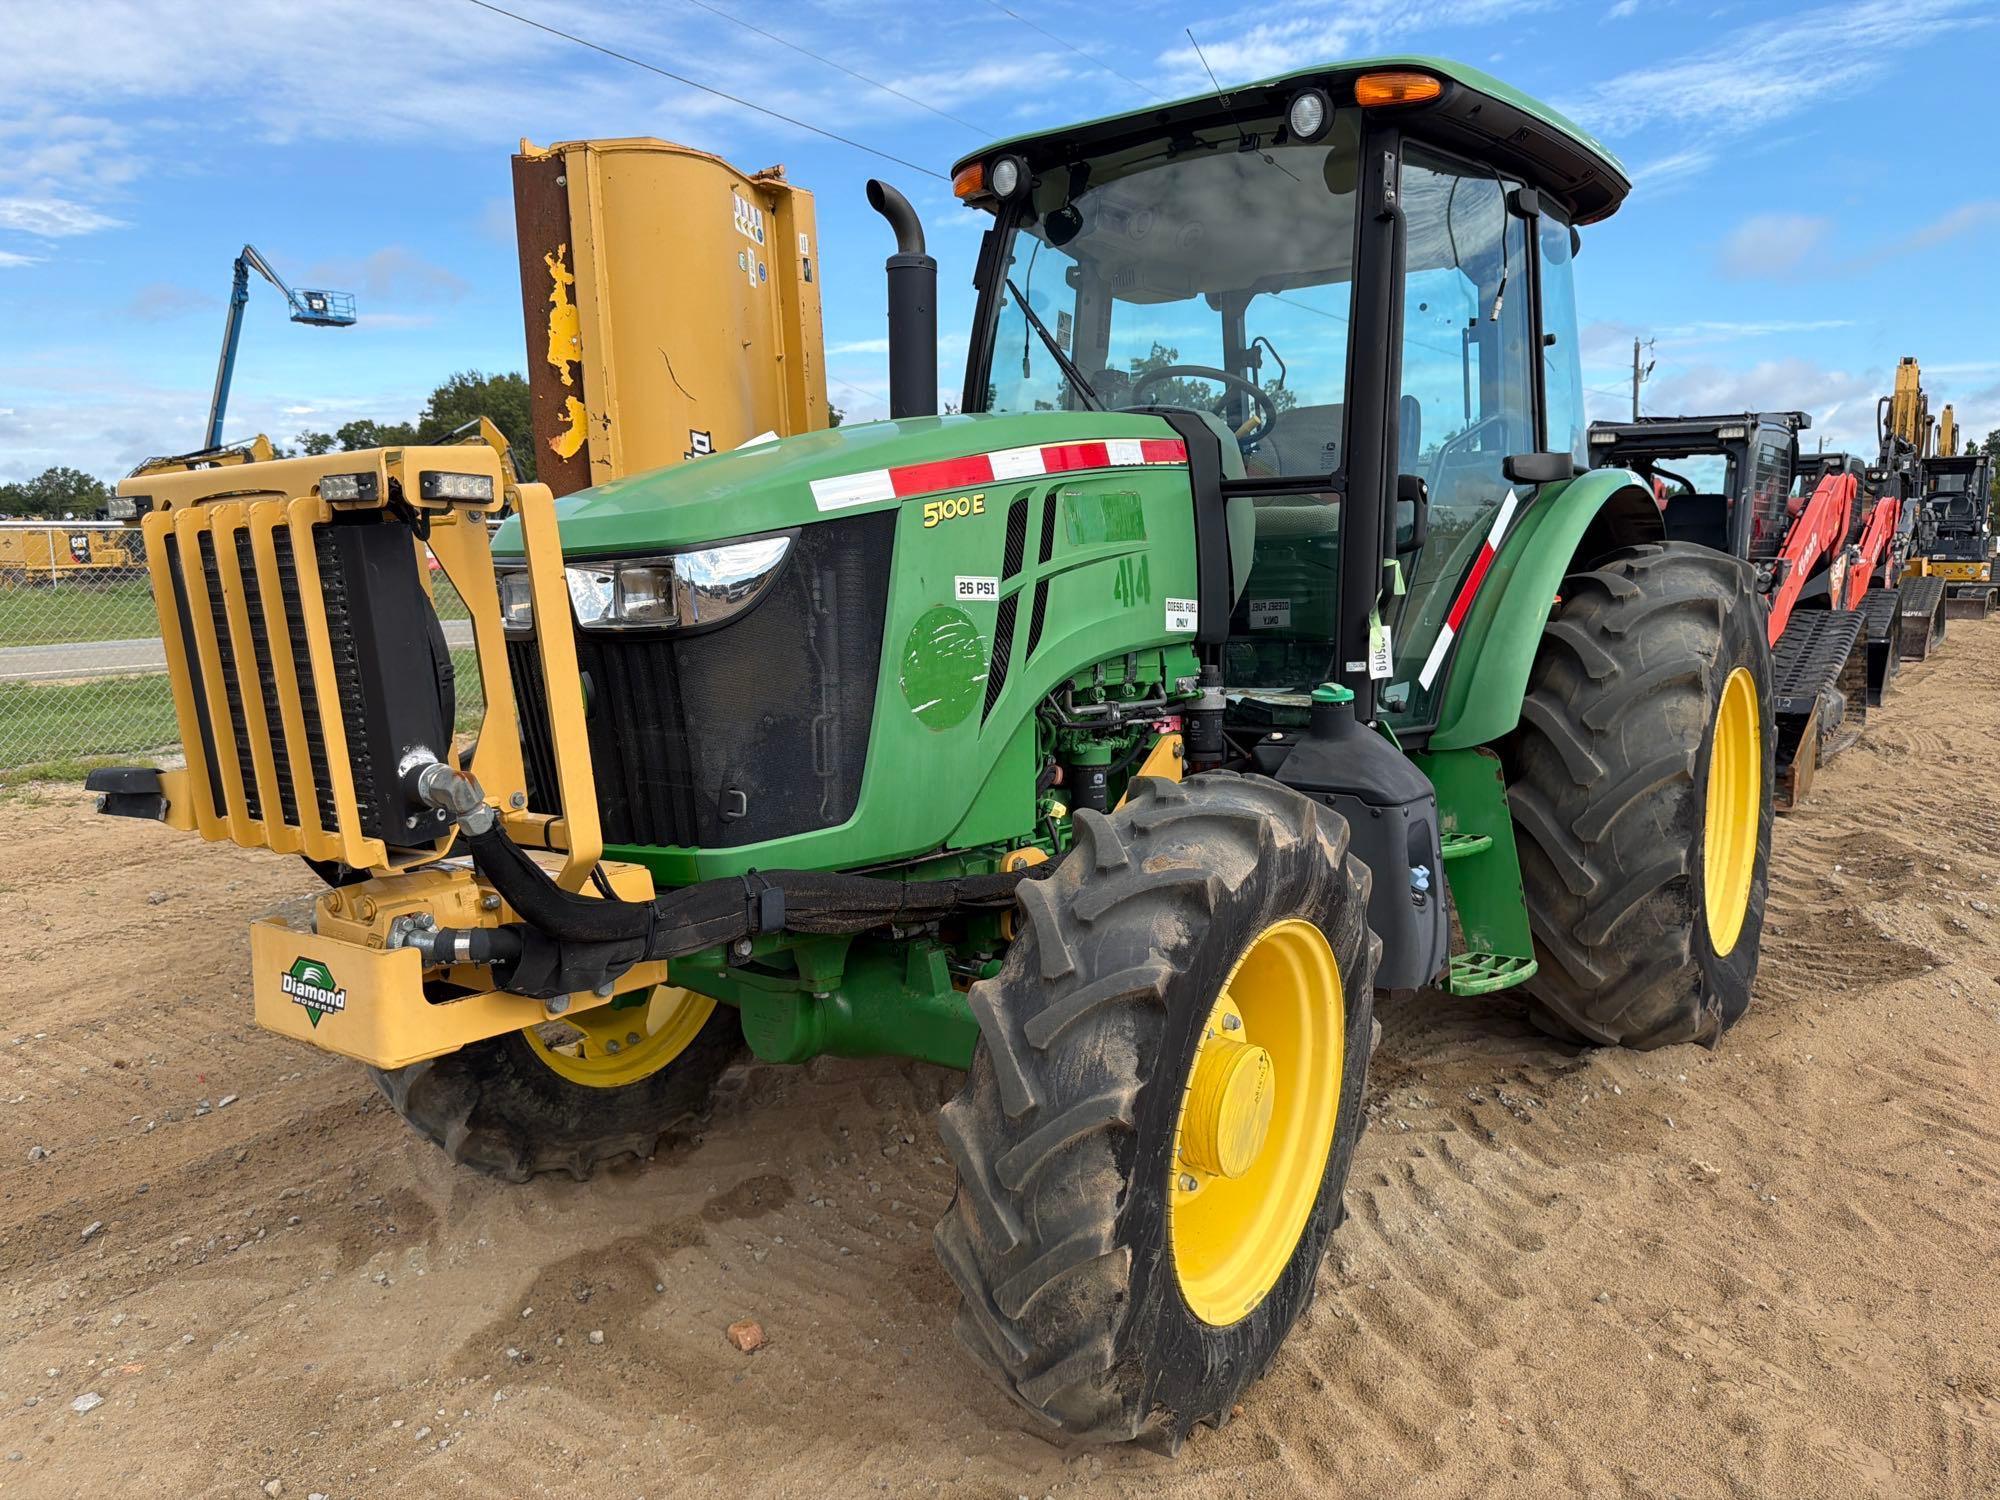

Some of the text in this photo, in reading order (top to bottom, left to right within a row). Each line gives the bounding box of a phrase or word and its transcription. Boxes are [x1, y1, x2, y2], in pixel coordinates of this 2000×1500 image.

[71, 536, 88, 548] CAT
[1113, 554, 1150, 608] 414
[959, 582, 996, 595] 26 PSI
[1167, 601, 1197, 613] DIESEL FUEL
[1175, 617, 1189, 628] ONLY
[282, 973, 345, 1009] Diamond
[293, 996, 335, 1013] MOWERS
